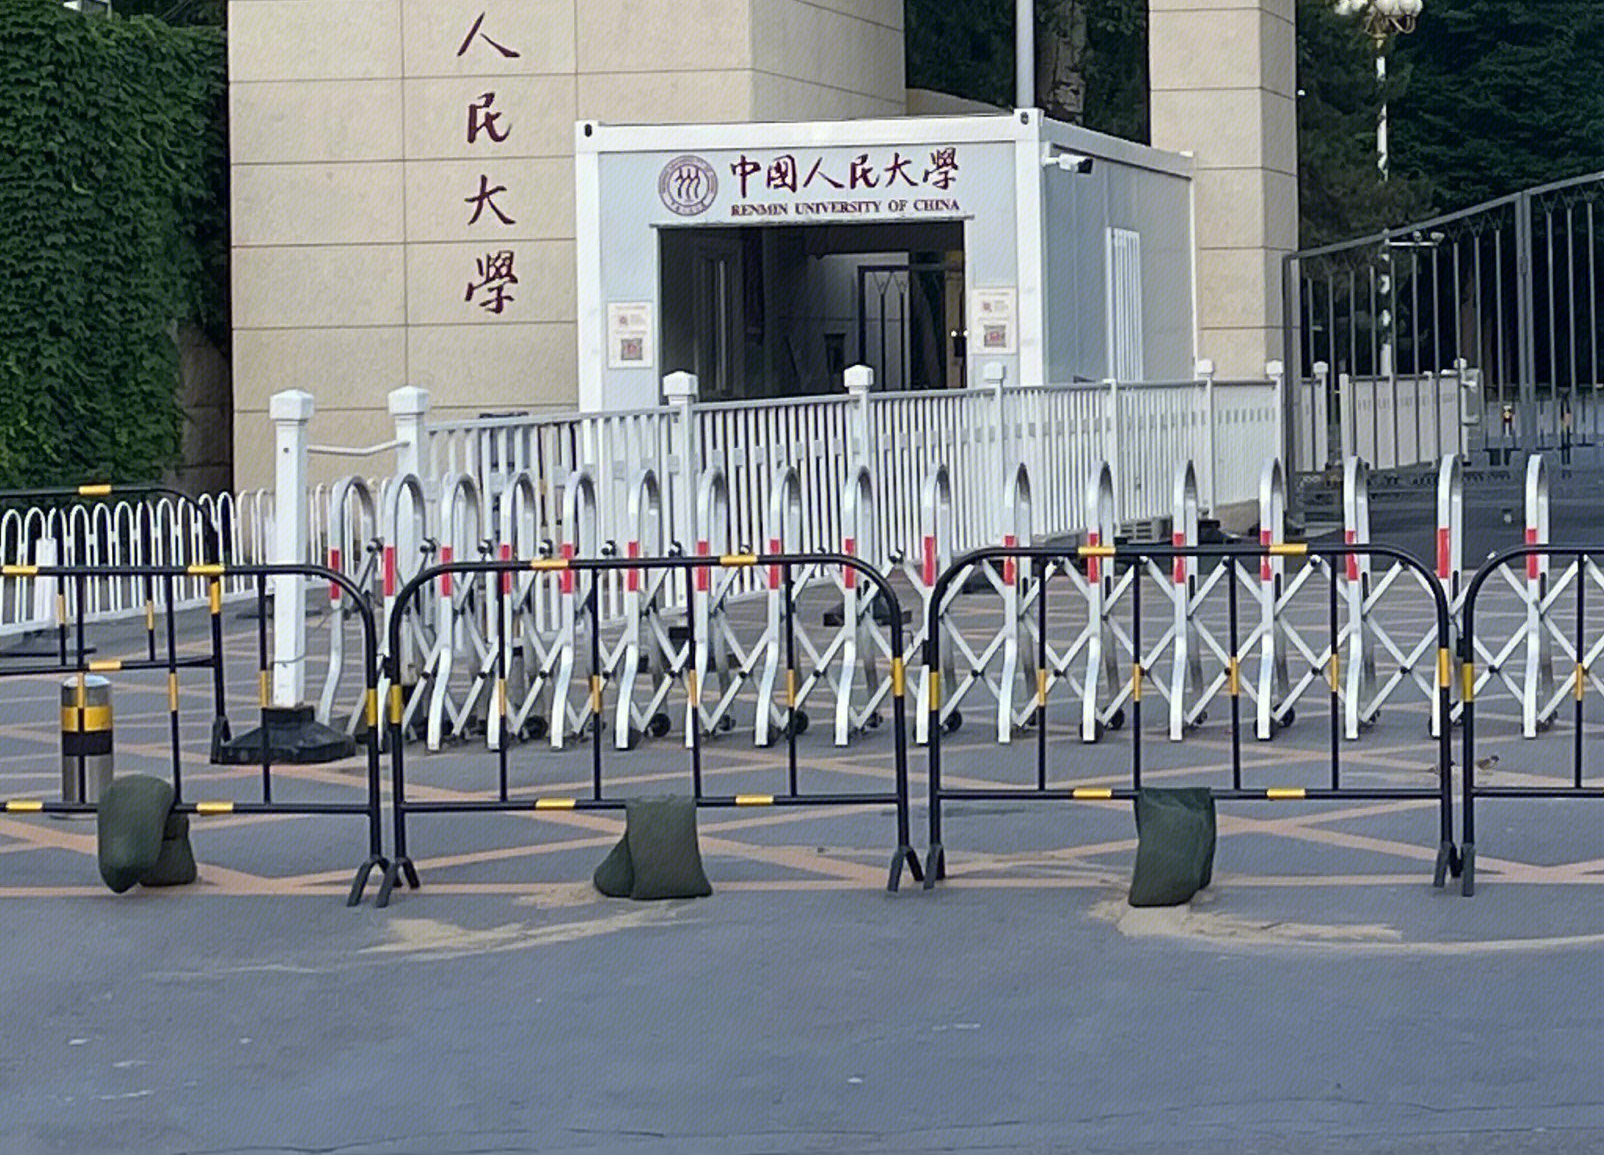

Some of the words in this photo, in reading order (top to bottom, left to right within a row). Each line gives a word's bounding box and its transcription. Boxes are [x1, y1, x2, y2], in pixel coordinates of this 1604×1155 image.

[730, 147, 959, 198] 中國人民大學
[731, 203, 788, 216] RENMIN
[795, 201, 881, 215] UNIVERSITY
[888, 200, 908, 212] OF
[913, 199, 961, 211] CHINA
